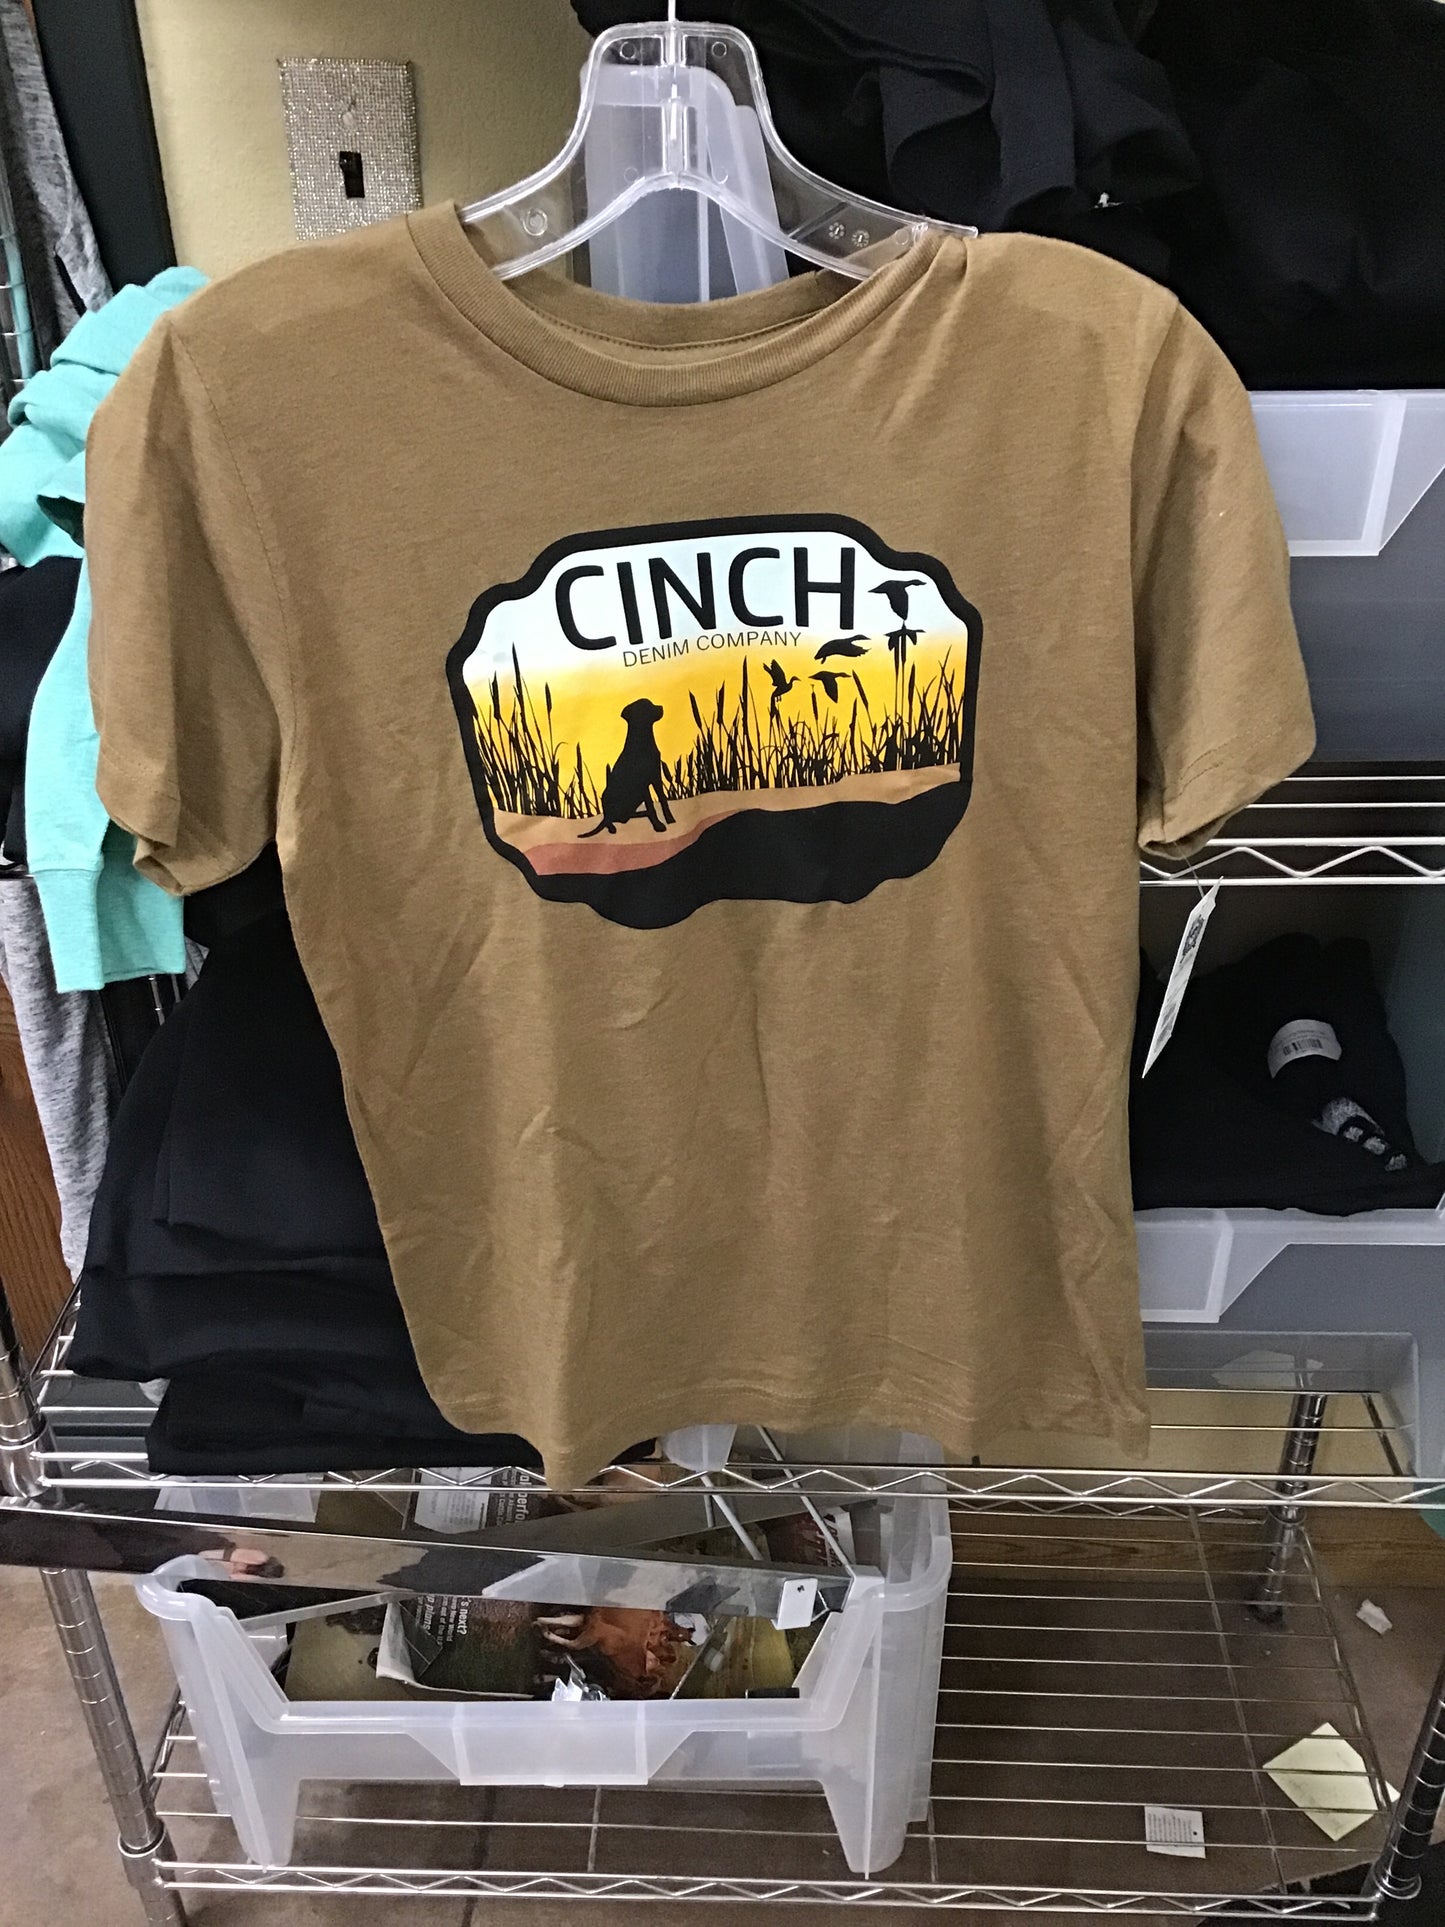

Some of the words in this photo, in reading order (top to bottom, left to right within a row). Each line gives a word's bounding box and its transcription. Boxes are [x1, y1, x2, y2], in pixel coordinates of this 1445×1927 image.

[555, 547, 856, 651] CINCH
[623, 638, 690, 668] DENIM
[696, 630, 802, 652] COMPANY
[514, 1492, 529, 1523] perfo
[456, 1608, 469, 1635] next?
